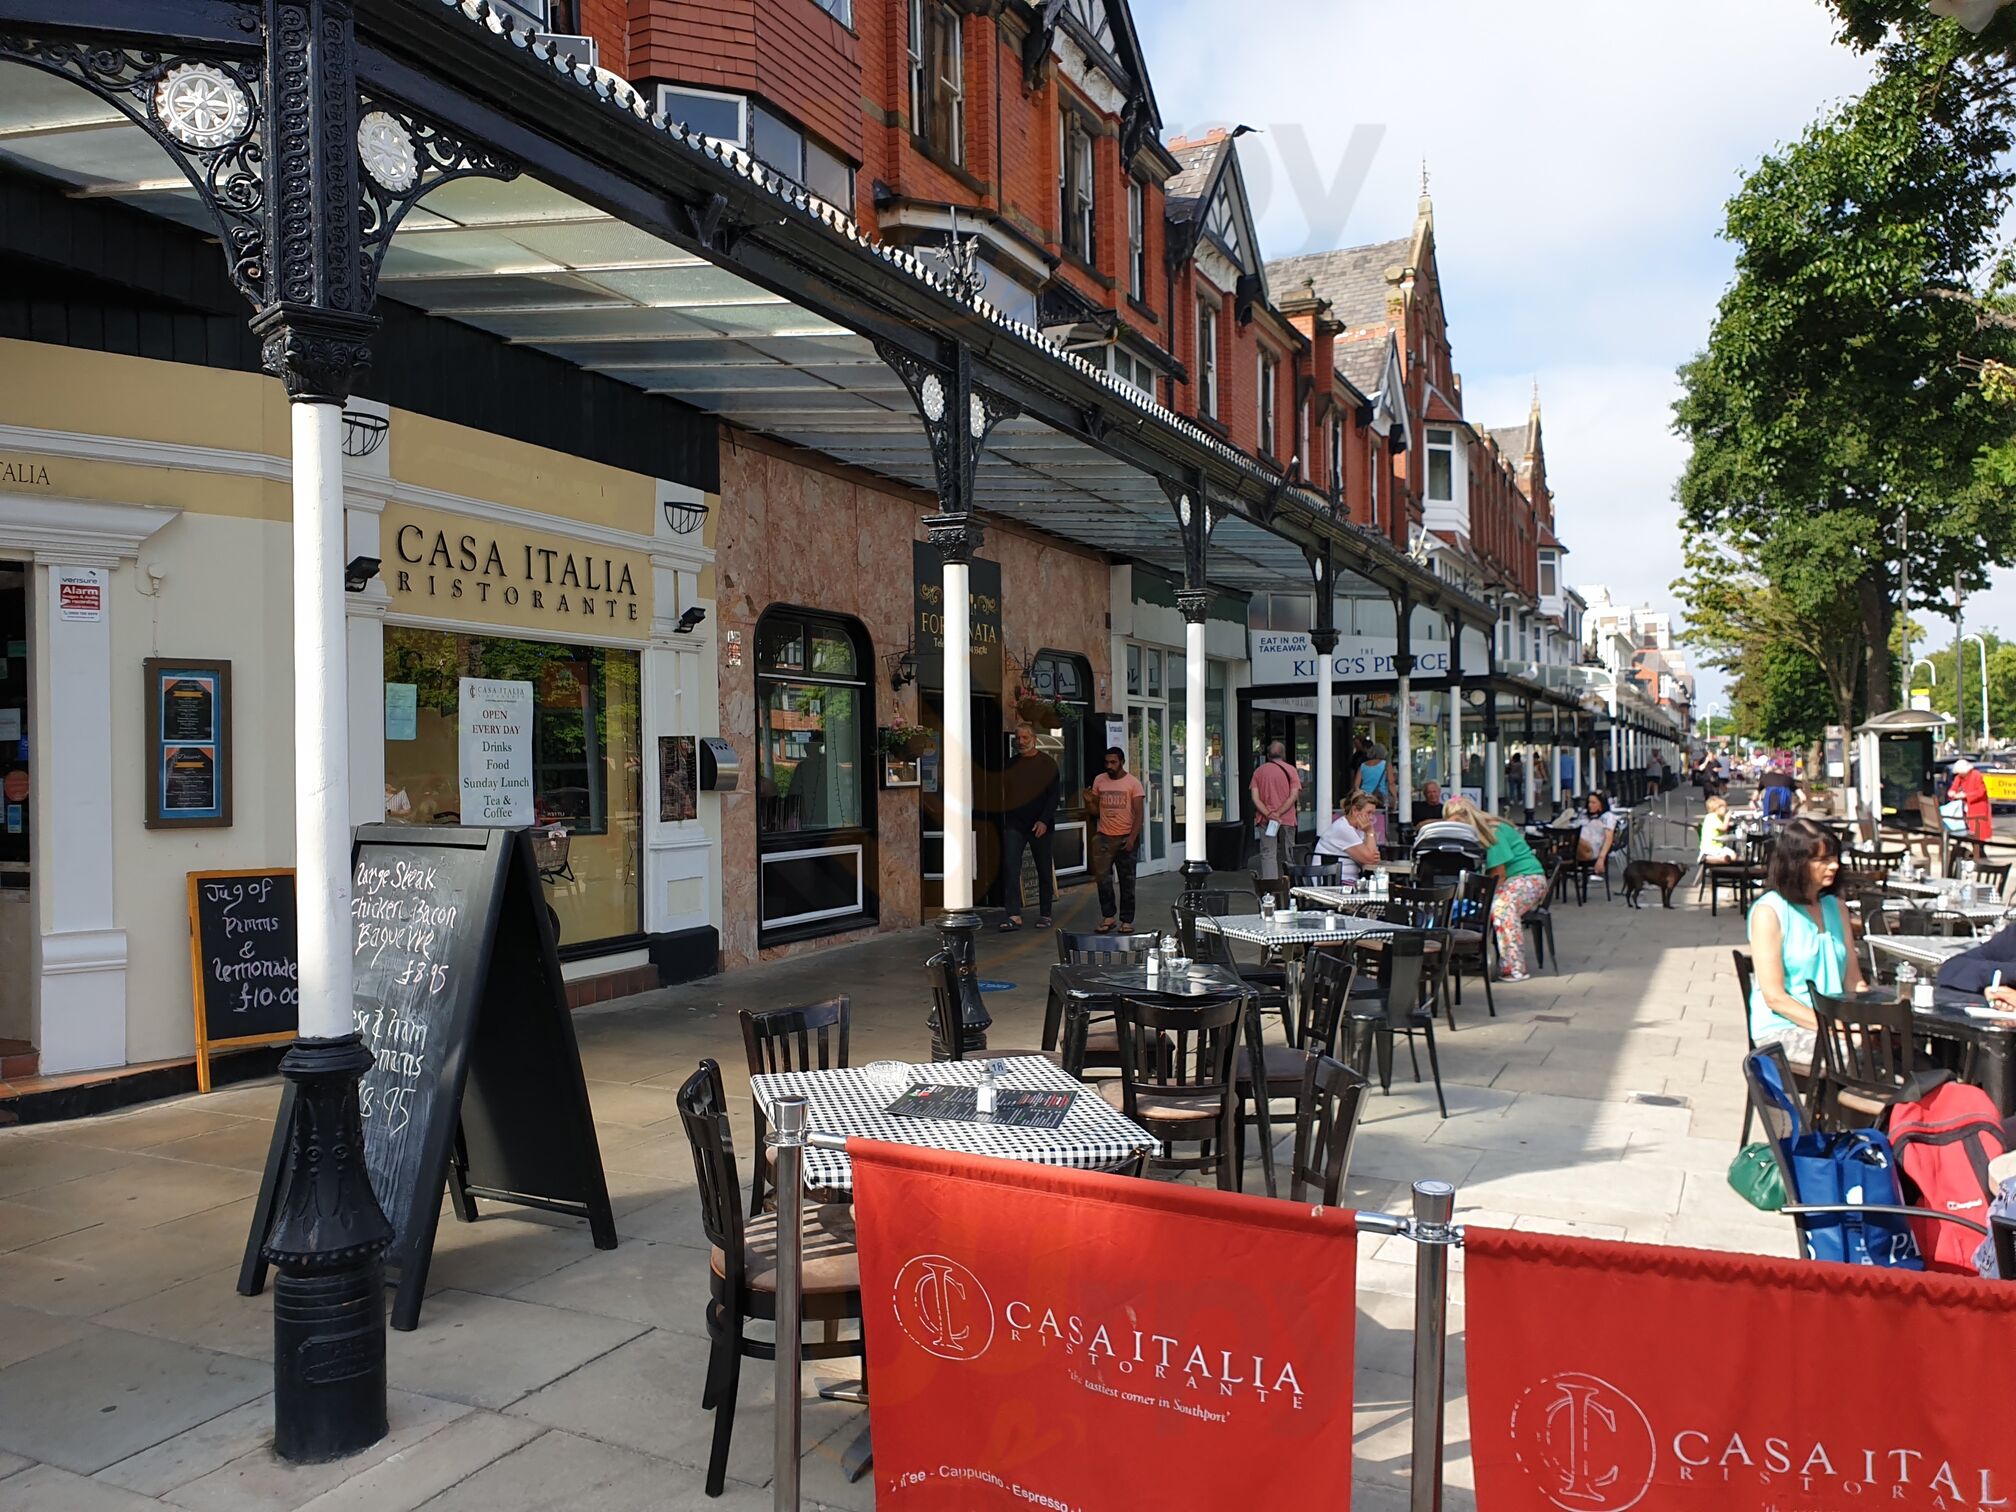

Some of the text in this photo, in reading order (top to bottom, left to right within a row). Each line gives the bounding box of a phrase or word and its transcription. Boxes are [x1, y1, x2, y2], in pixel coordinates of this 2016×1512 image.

[397, 524, 637, 596] CASA ITALIA
[63, 586, 98, 595] Alarm
[398, 571, 638, 621] RISTORANTE
[1258, 644, 1308, 653] TAKEAWAY
[1260, 636, 1305, 645] EAT IN OR
[1293, 653, 1448, 676] KIG'S PLICE
[482, 710, 508, 720] OPEN
[472, 725, 520, 735] EVERY DAY
[482, 741, 512, 752] Drinks
[486, 760, 510, 770] Food
[463, 777, 529, 791] Sunday Lunch
[484, 796, 511, 806] Tea &
[483, 808, 512, 818] Coffee
[204, 884, 243, 914] Jug
[411, 896, 457, 928] Bacon
[239, 941, 256, 959] &
[394, 960, 449, 995] £8.95
[233, 982, 299, 1012] £10.00
[992, 1062, 1004, 1072] 18
[1006, 1301, 1305, 1396] CASA ITALIA
[1011, 1329, 1303, 1410] RISTORANTE
[1084, 1379, 1119, 1399] tastiest
[1121, 1390, 1155, 1405] corner
[1158, 1395, 1171, 1409] in
[1672, 1429, 2008, 1504] CASA ITAL
[1011, 1483, 1069, 1512] Espresso
[1680, 1465, 1993, 1512] RISTORA
